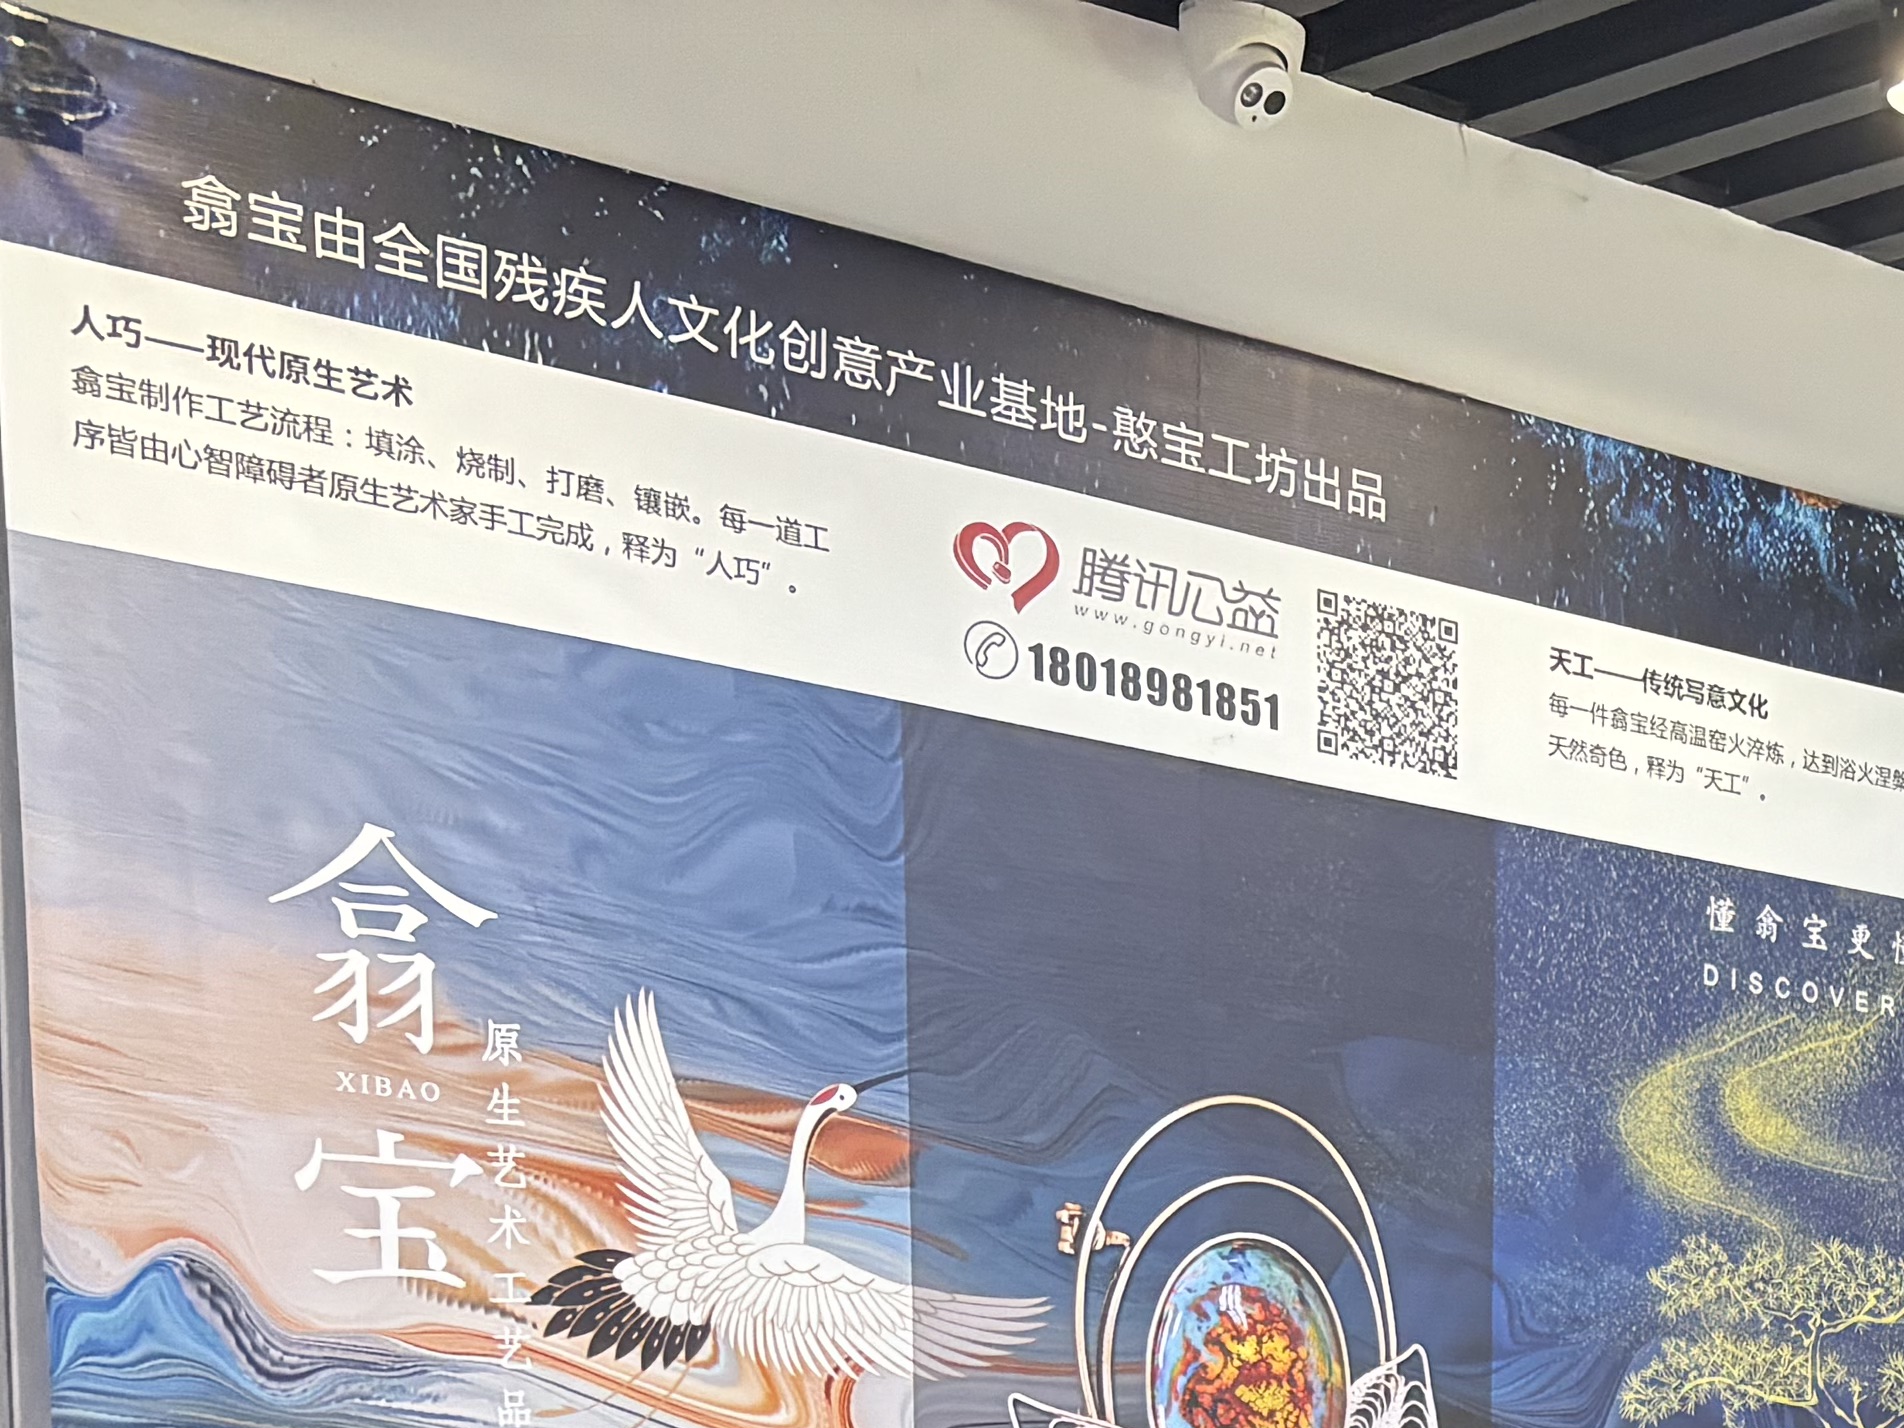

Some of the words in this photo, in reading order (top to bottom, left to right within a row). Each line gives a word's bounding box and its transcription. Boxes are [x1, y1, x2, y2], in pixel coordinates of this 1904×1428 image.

[181, 173, 1388, 523] 翕宝由全国残疾人文化创意产业基地-憨宝工坊出品
[1071, 542, 1282, 640] 腾讯公益
[1073, 601, 1280, 660] www.gongyi.net
[1027, 640, 1281, 733] 18018981851
[1549, 645, 1769, 720] 天工——传统写意文化
[335, 1069, 441, 1104] XIBAO
